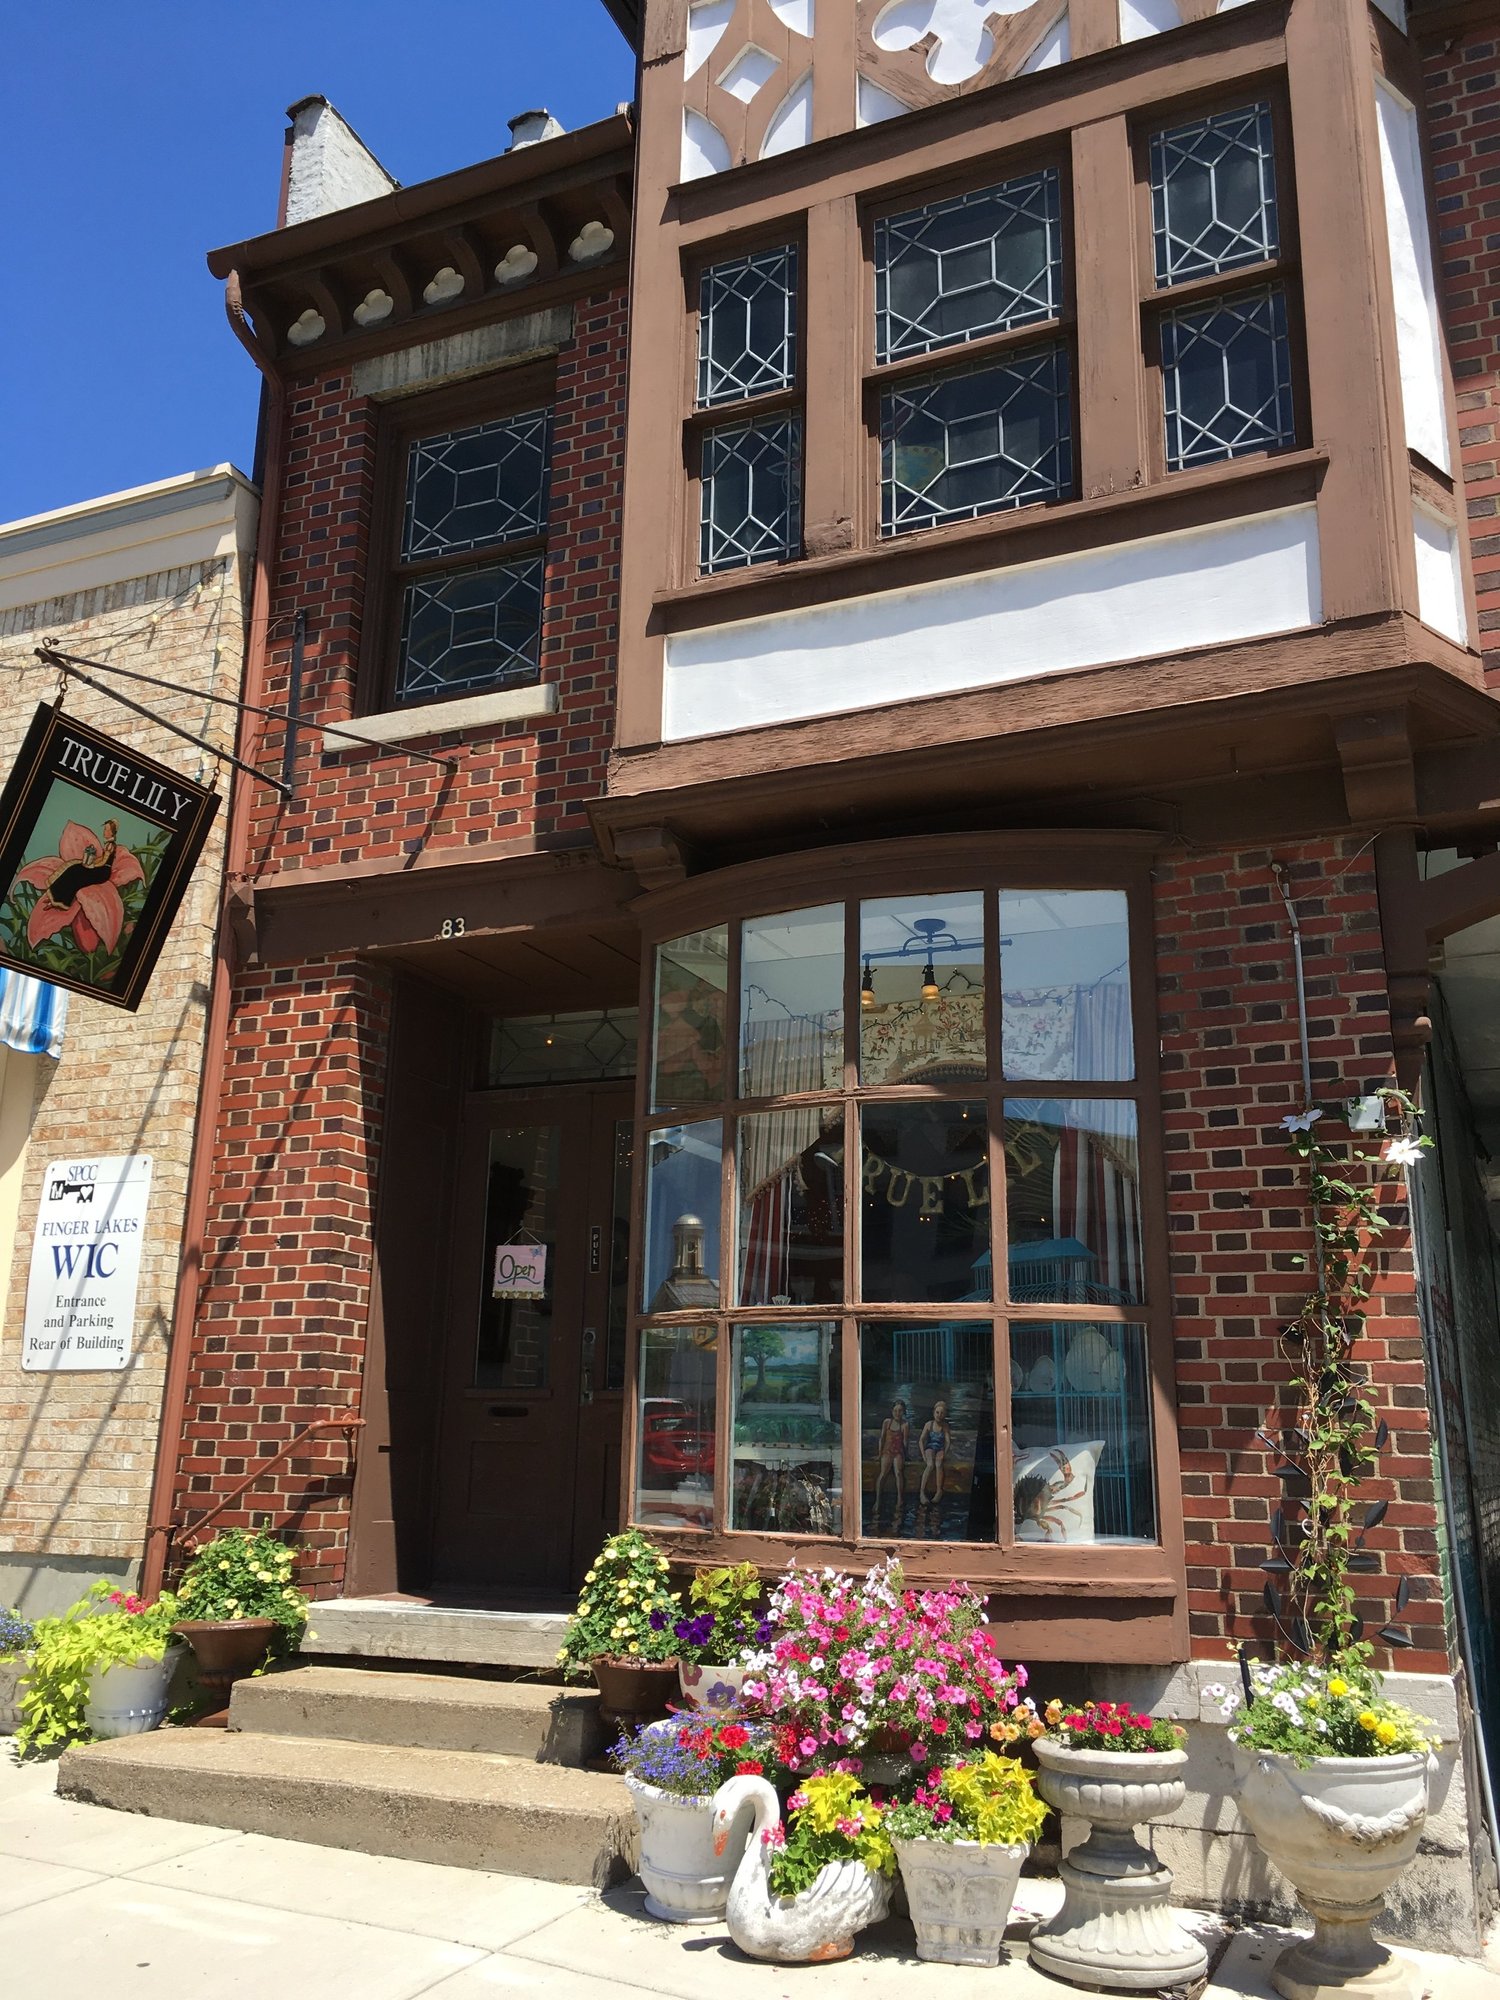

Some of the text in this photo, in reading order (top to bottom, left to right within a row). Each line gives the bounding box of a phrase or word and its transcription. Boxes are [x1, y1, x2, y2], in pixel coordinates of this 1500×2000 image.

[58, 736, 192, 821] TRUE LILY
[441, 917, 465, 938] 83
[67, 1164, 99, 1182] SPCC
[832, 1146, 944, 1214] RUE
[42, 1217, 138, 1237] FINGER LAKES
[51, 1242, 119, 1280] WIC
[499, 1254, 537, 1285] Open
[55, 1295, 107, 1308] Entrance
[43, 1313, 114, 1330] and Parking
[29, 1335, 124, 1352] Rear of Building
